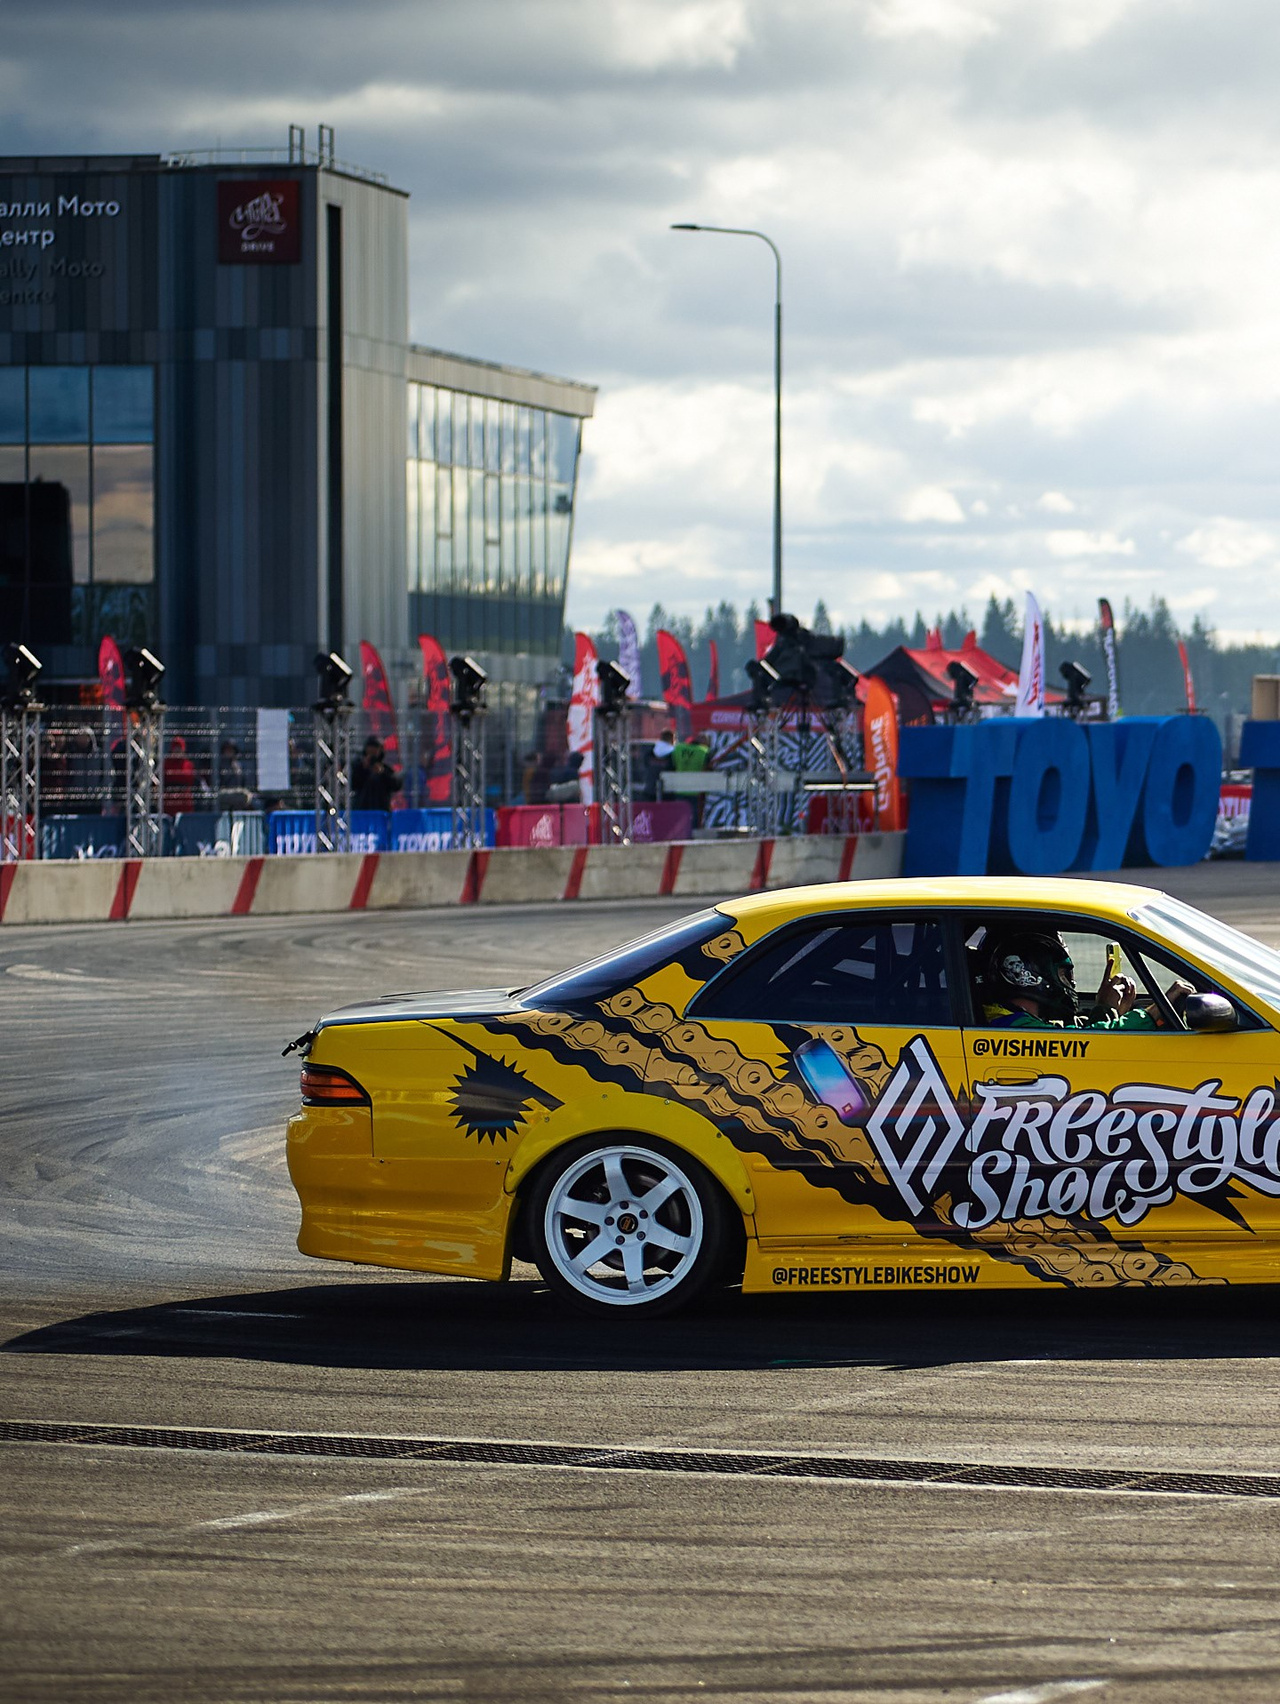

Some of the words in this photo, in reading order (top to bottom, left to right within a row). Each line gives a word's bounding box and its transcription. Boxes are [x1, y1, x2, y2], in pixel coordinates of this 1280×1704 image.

[57, 195, 120, 217] Мото
[0, 229, 55, 250] ентр
[945, 716, 1223, 876] TOYO
[973, 1038, 1090, 1058] @VISHNEVIY
[772, 1265, 981, 1285] @FREESTYLEBIKESHOW
